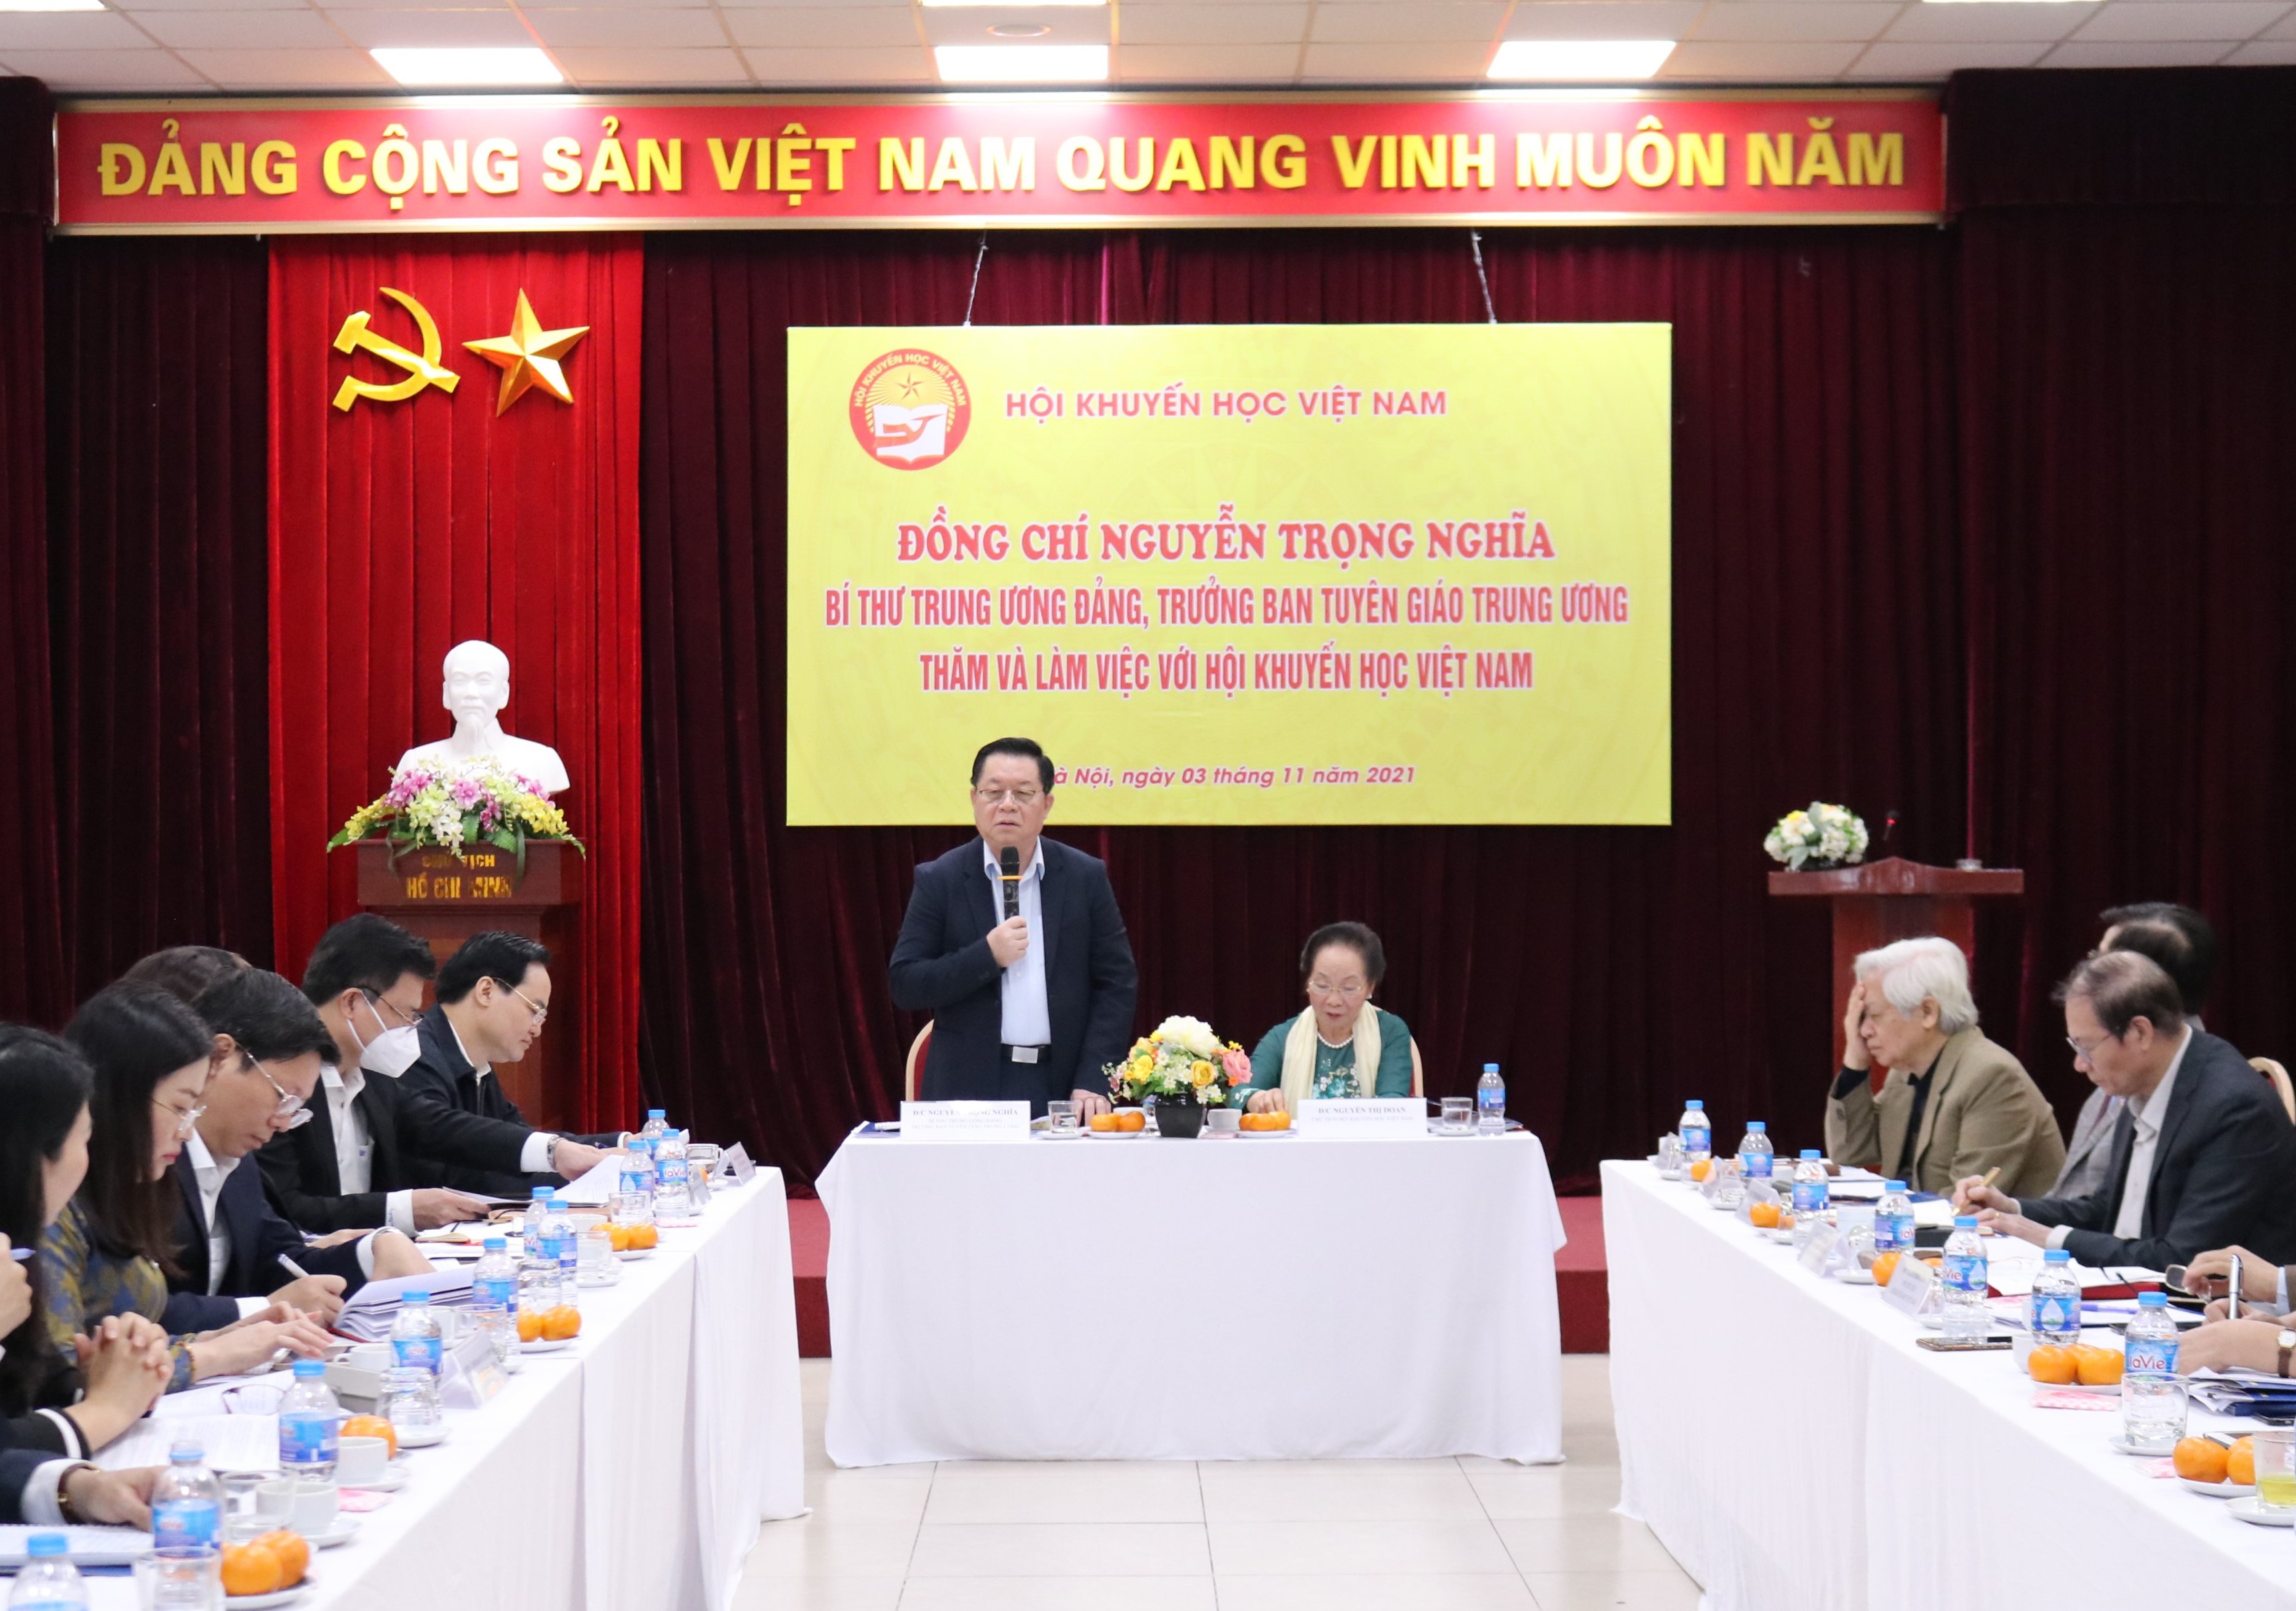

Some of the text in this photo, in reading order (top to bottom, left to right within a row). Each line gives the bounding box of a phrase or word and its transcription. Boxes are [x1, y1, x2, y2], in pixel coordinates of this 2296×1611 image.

[98, 115, 1903, 211] ĐẢNG CỘNG SẢN VIỆT NAM QUANG VINH MUÔN NĂM
[855, 353, 967, 407] HỘI KHUYẾN HỌC VIỆT NAM
[1007, 383, 1445, 423] HỘI KHUYẾN HỌC VIỆT NAM
[897, 503, 1555, 569] ĐỒNG CHÍ NGUYỄN TRỌNG NGHĨA
[825, 575, 1628, 631] BÍ THƯ TRUNG ƯƠNG ĐẢNG, TRƯỞNG BAN TUYÊN GIÁO TRUNG ƯƠNG
[919, 641, 1533, 699] THĂM VÀ LÀM VIỆC VỚI HỘI KHUYẾN HỌC VIỆT NAM
[1054, 766, 1415, 789] à Nội, ngày 03 tháng 11 năm 2021
